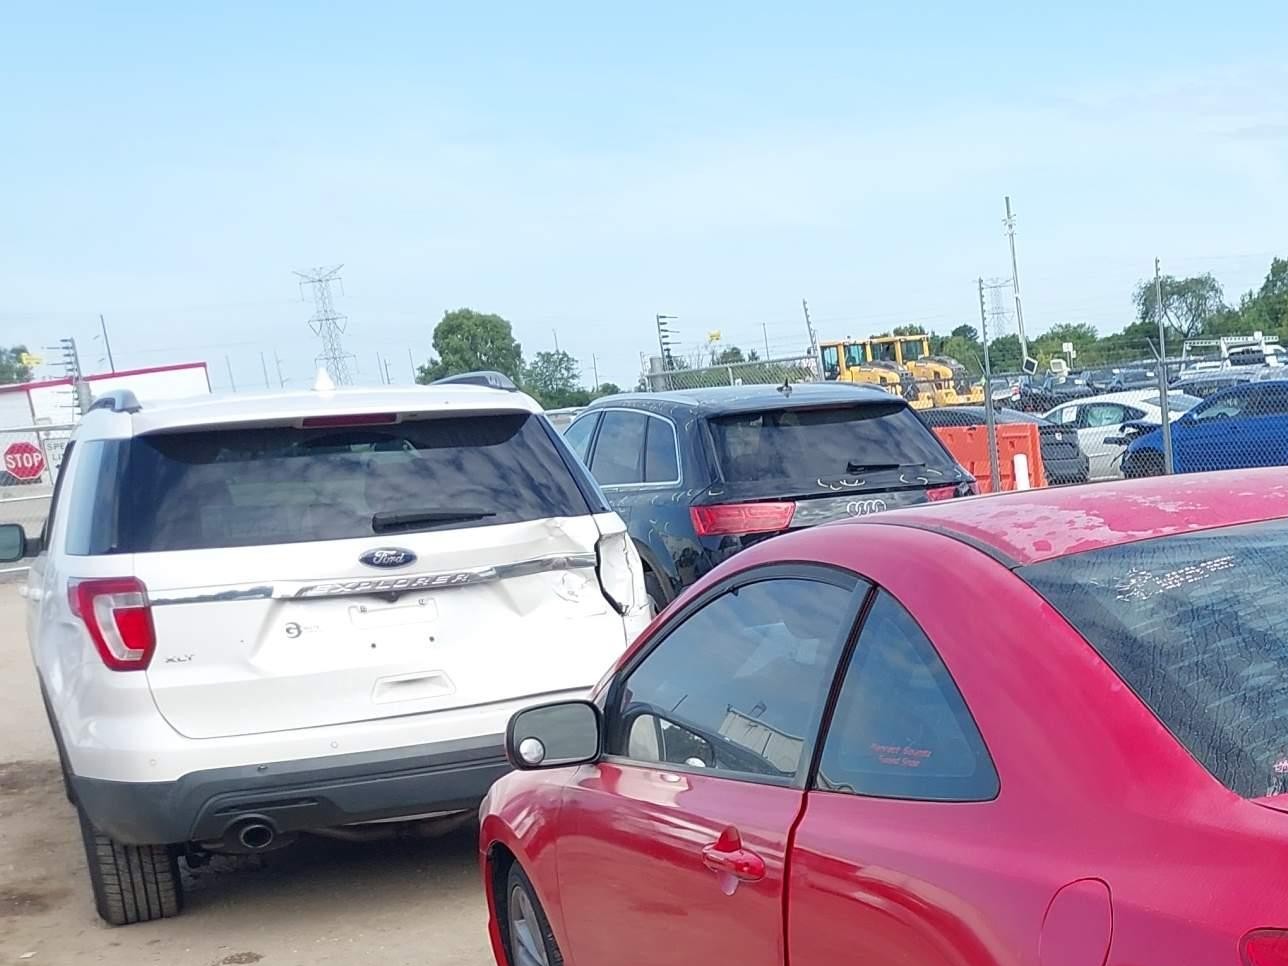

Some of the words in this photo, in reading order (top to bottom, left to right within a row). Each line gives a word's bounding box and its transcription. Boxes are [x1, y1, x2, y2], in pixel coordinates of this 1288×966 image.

[6, 452, 42, 469] STOP
[373, 549, 405, 565] Ford
[313, 571, 471, 594] EXPLORER
